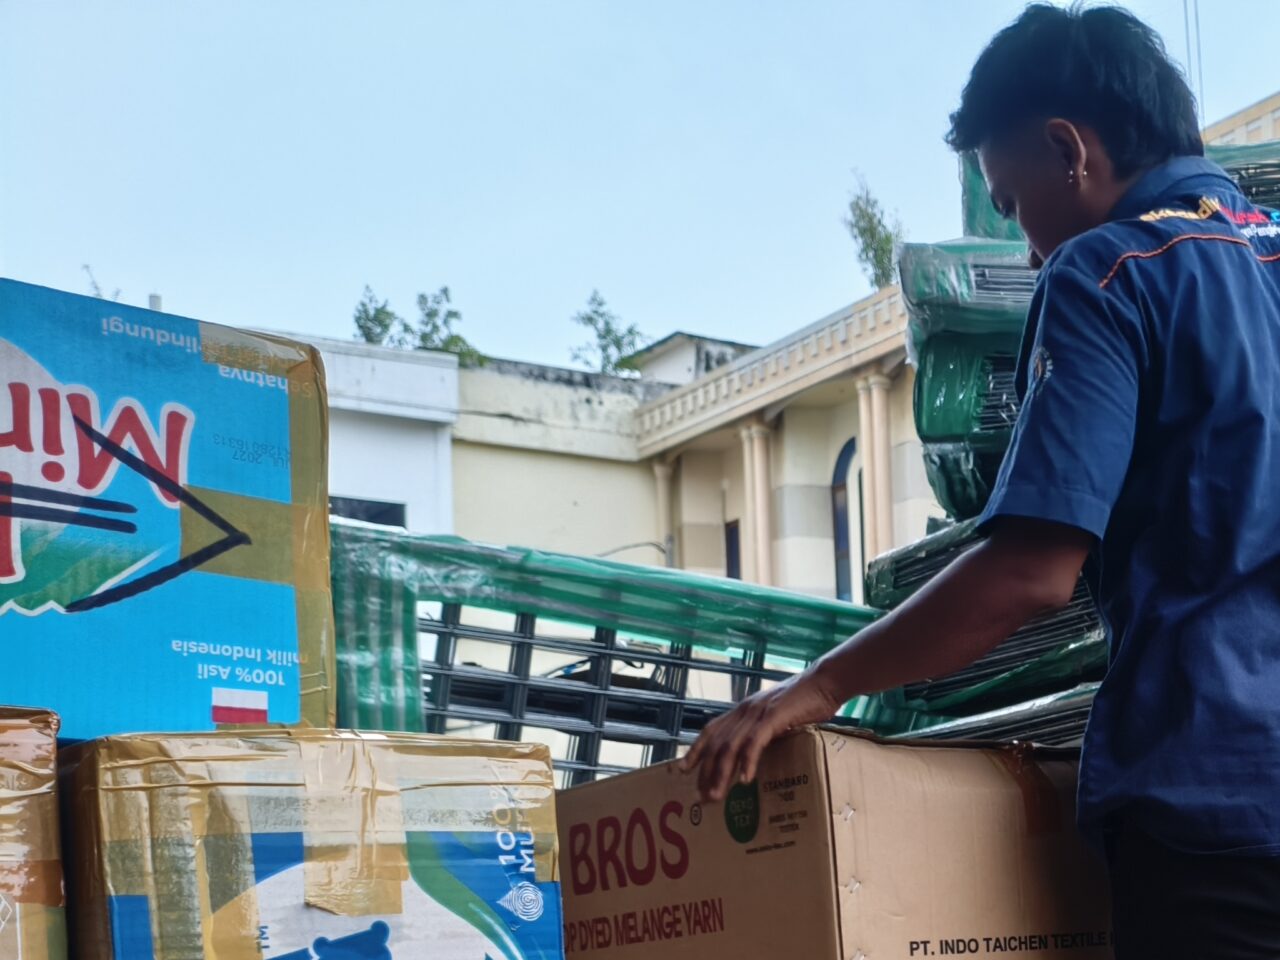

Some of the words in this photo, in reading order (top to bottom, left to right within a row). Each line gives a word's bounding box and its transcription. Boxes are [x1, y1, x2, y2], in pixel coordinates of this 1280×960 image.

[171, 639, 262, 662] Indonesia
[197, 663, 231, 680] Asli
[235, 667, 285, 686] 100%
[569, 801, 690, 896] BROS
[578, 915, 612, 951] DYED
[614, 902, 683, 947] MELANGE
[682, 897, 725, 937] YARN
[909, 939, 936, 957] PT.
[938, 937, 980, 956] INDO
[982, 934, 1049, 953] TAICHEN
[1051, 930, 1107, 949] TEXTILE
